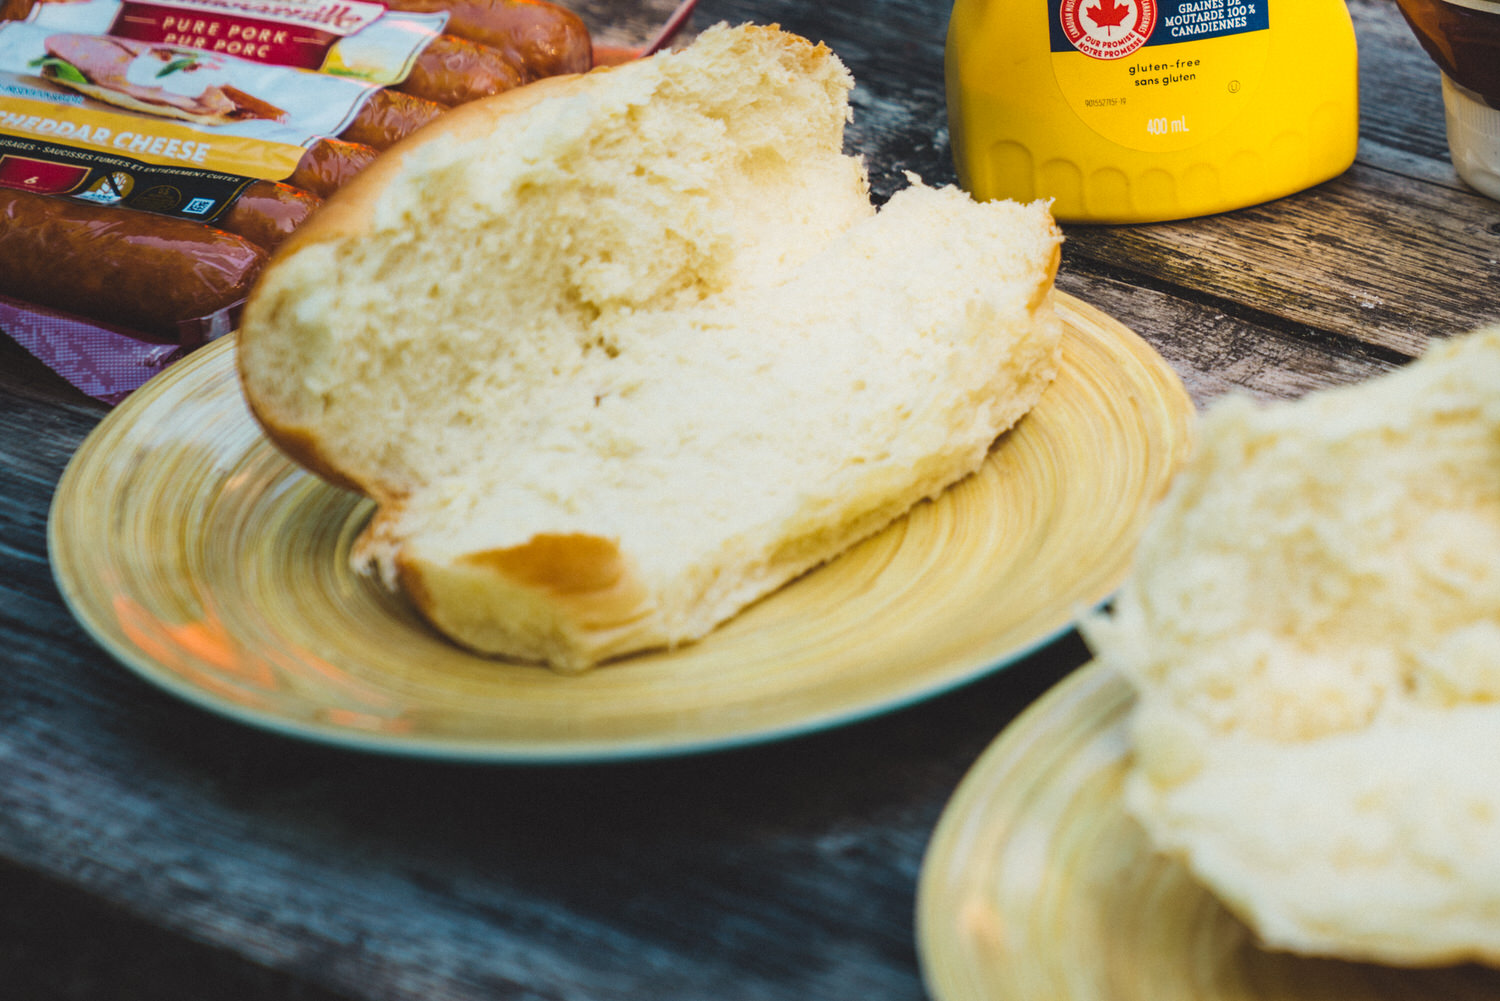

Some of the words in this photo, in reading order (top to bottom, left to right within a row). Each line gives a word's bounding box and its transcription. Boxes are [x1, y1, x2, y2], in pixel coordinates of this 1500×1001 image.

[1165, 9, 1224, 27] MOUTARDE
[1171, 16, 1247, 37] CANADIENNES
[162, 16, 217, 37] PURE
[228, 25, 288, 45] PORK
[1085, 36, 1100, 47] OUR
[1102, 32, 1135, 48] PROMISE
[164, 34, 207, 48] PUR
[214, 41, 271, 59] PORC
[1078, 42, 1102, 57] NOTRE
[1104, 38, 1143, 57] PROMESSE
[1129, 59, 1201, 75] gluten-free
[1135, 77, 1159, 86] sans
[1162, 73, 1196, 86] gluten
[1147, 117, 1168, 135] 400
[1171, 115, 1190, 132] mL
[112, 131, 211, 162] CHEESE
[0, 140, 36, 151] USAGES
[42, 145, 94, 161] SAUCISSES
[206, 173, 241, 183] CUITES
[24, 176, 39, 185] 6
